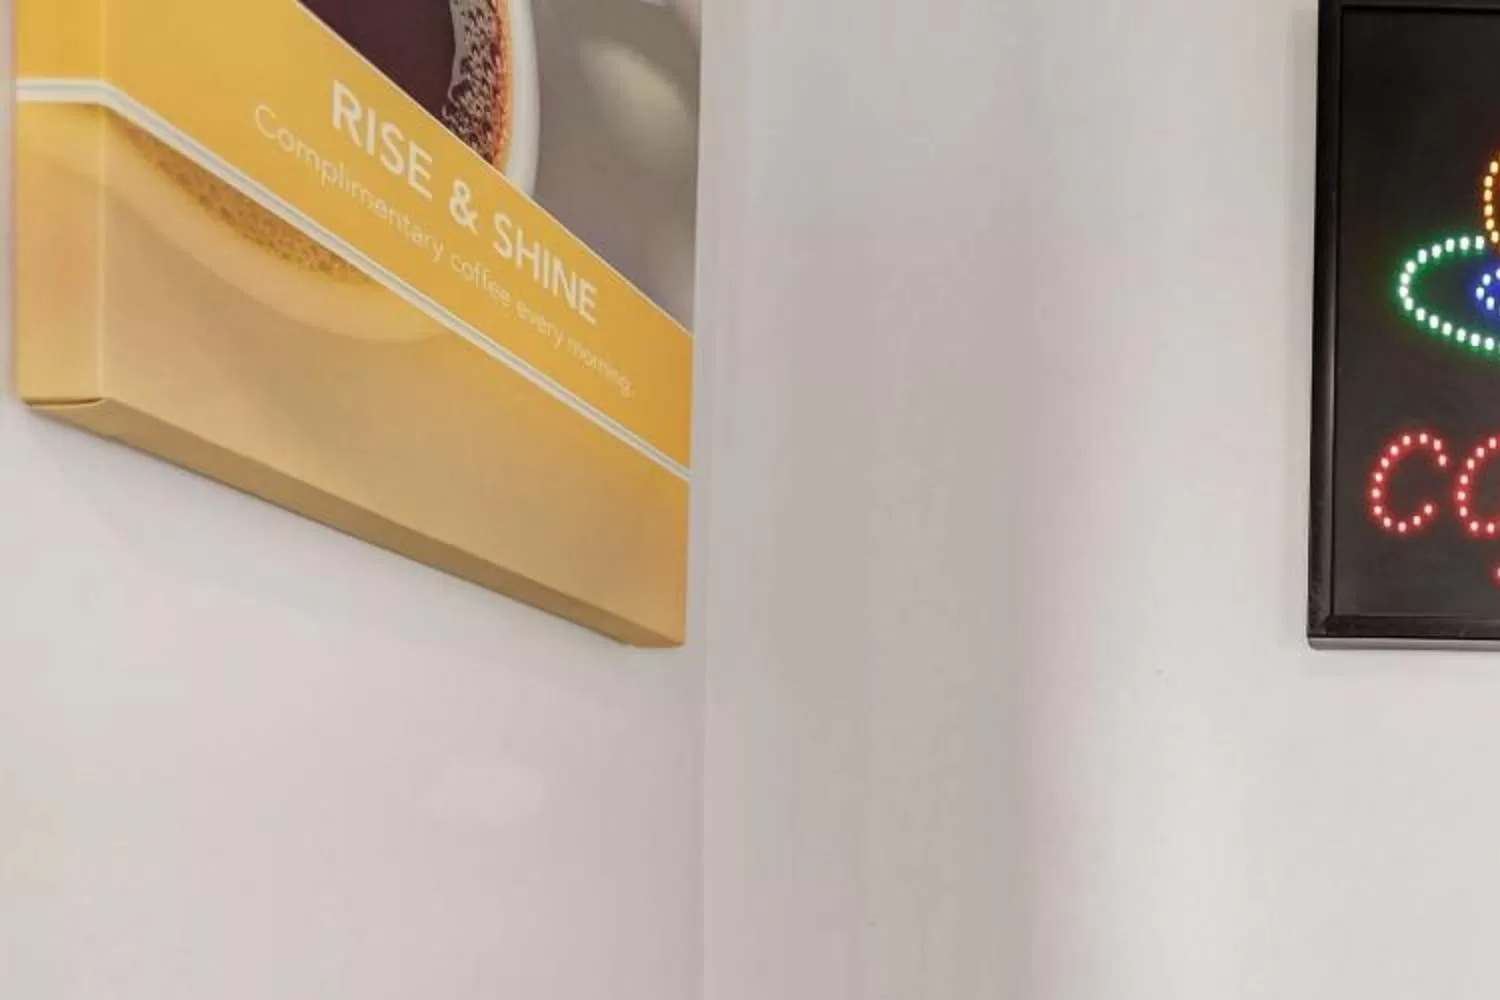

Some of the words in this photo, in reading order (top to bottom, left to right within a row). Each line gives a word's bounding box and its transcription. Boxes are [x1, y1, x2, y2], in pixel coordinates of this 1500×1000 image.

[255, 104, 443, 265] Complimentary
[451, 254, 512, 308] coffee
[515, 300, 564, 350] every
[331, 79, 433, 201] RISE
[449, 178, 479, 237] &
[492, 212, 597, 325] SHINE
